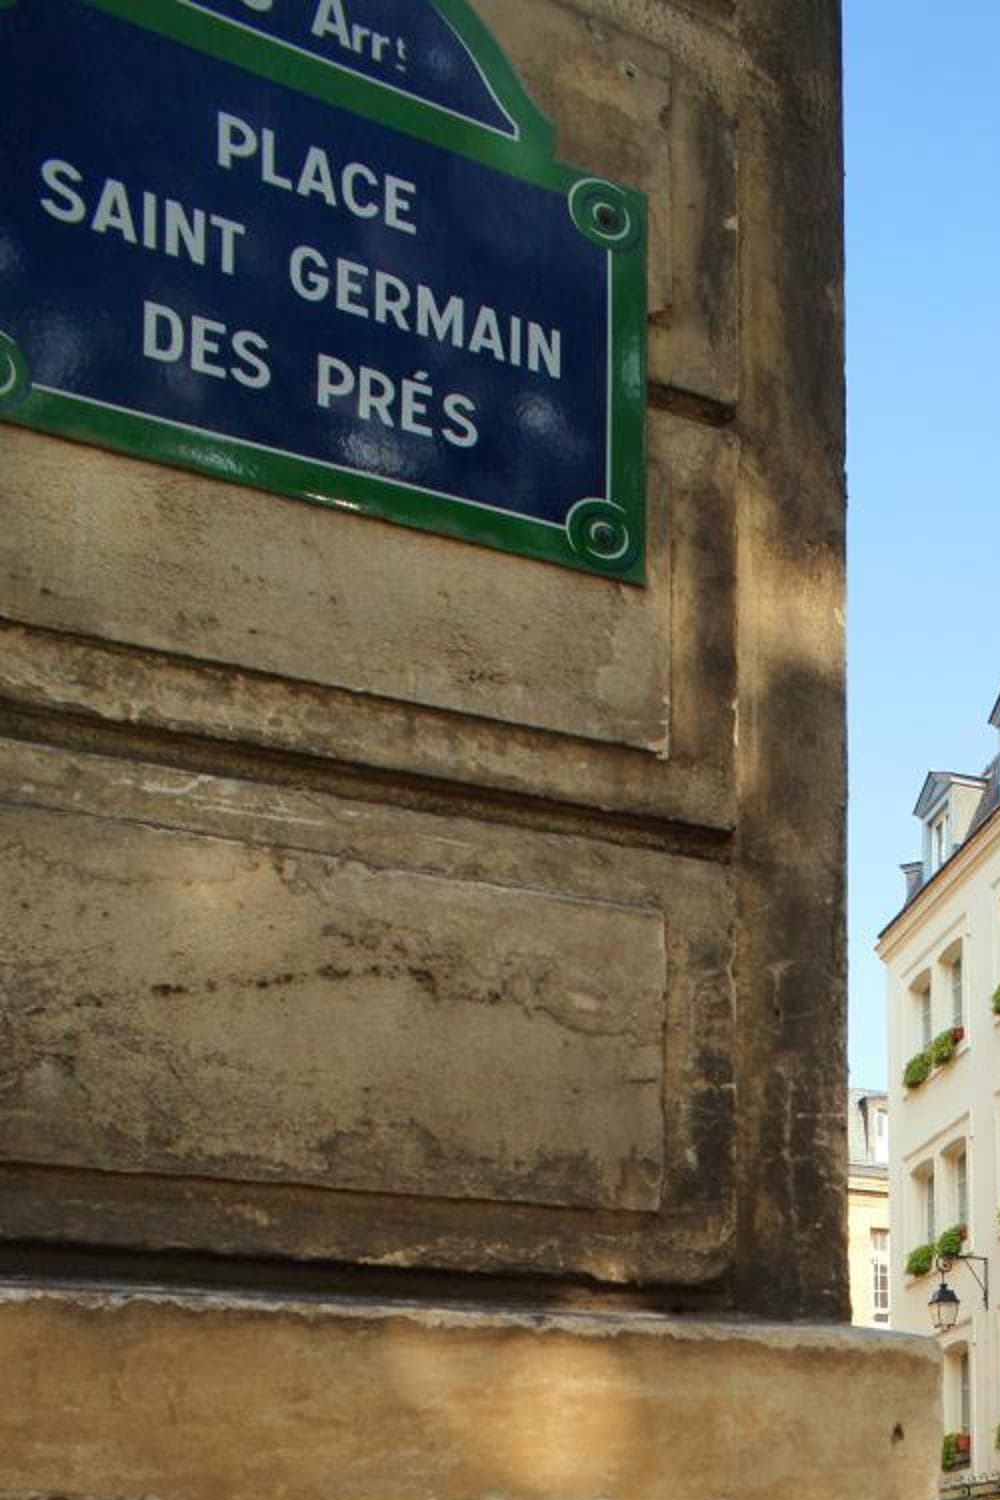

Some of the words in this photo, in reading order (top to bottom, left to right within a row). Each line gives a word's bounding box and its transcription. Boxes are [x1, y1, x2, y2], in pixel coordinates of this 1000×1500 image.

[216, 110, 418, 235] PLACE
[39, 158, 246, 275] SAINT
[289, 244, 562, 379] GERMAIN
[142, 300, 272, 390] DES
[317, 352, 479, 448] PRÉS
